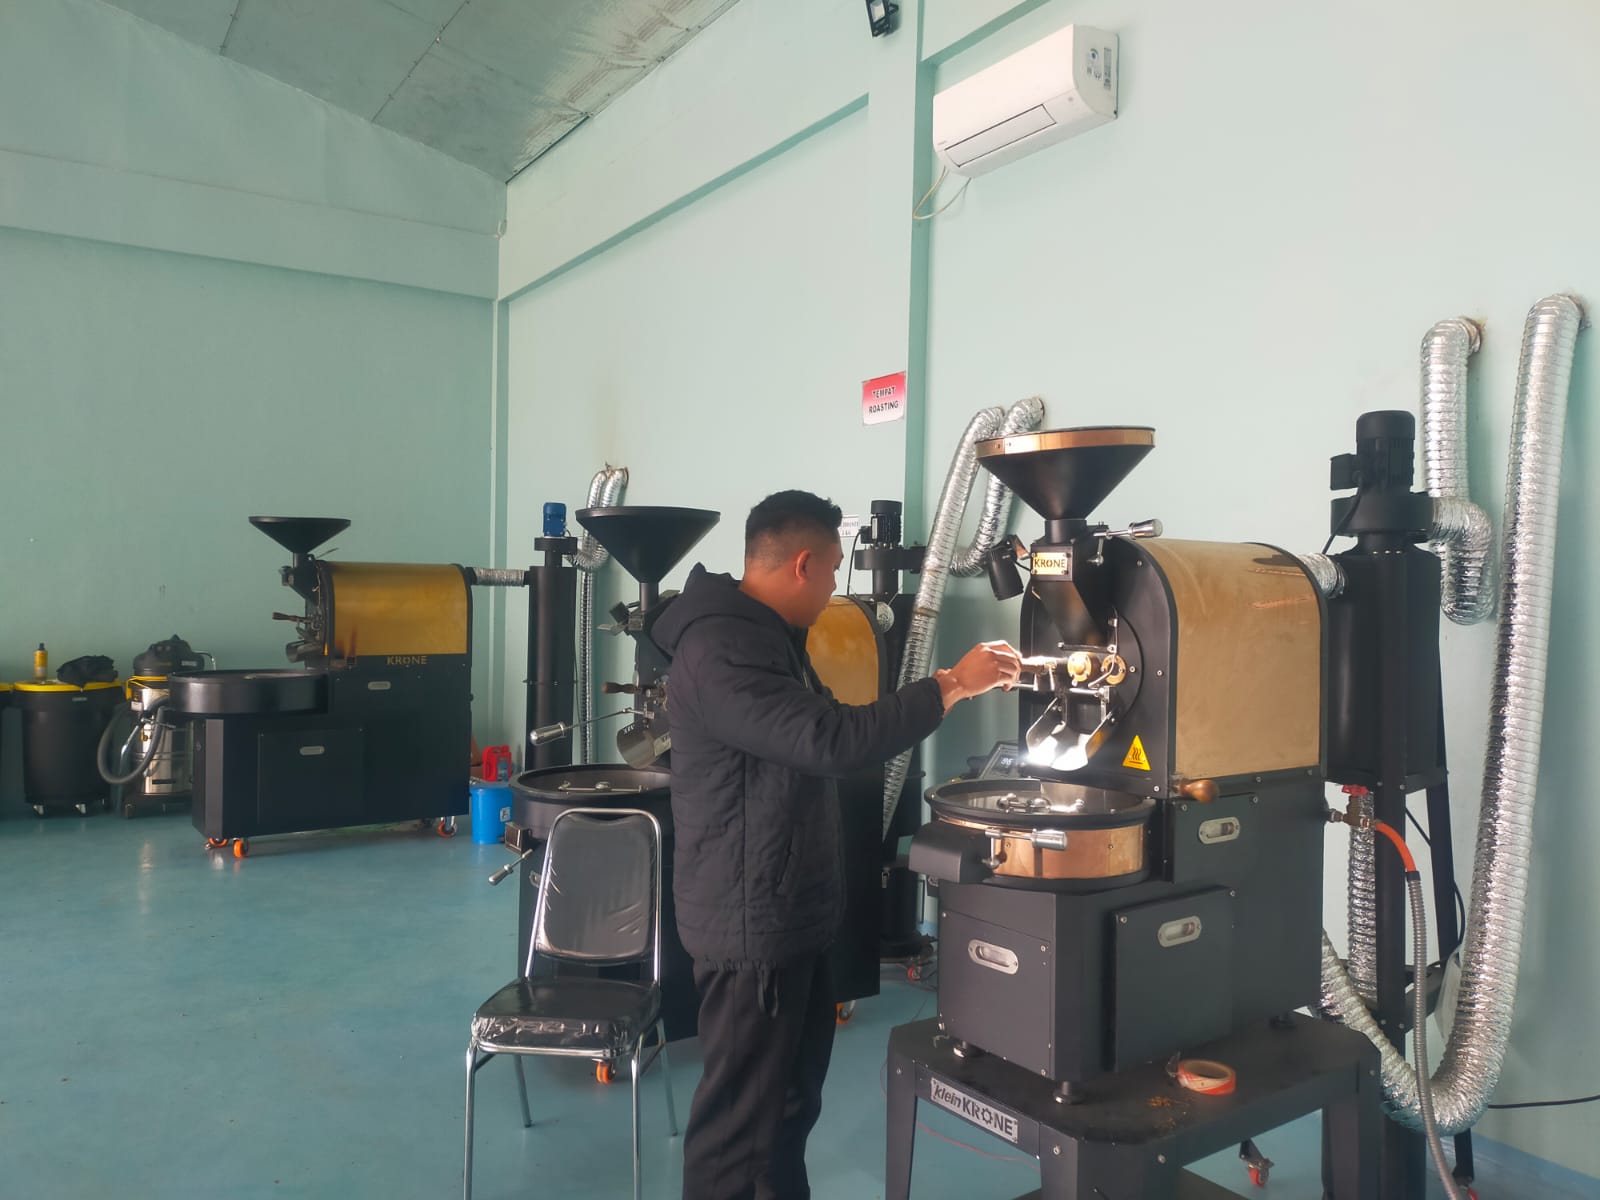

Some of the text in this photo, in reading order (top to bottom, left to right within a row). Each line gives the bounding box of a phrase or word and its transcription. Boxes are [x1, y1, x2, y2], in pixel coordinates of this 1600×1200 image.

[872, 386, 896, 398] TEMPAT
[868, 400, 899, 414] ROASTING
[1034, 558, 1066, 568] KRONE
[386, 655, 428, 665] KRONE
